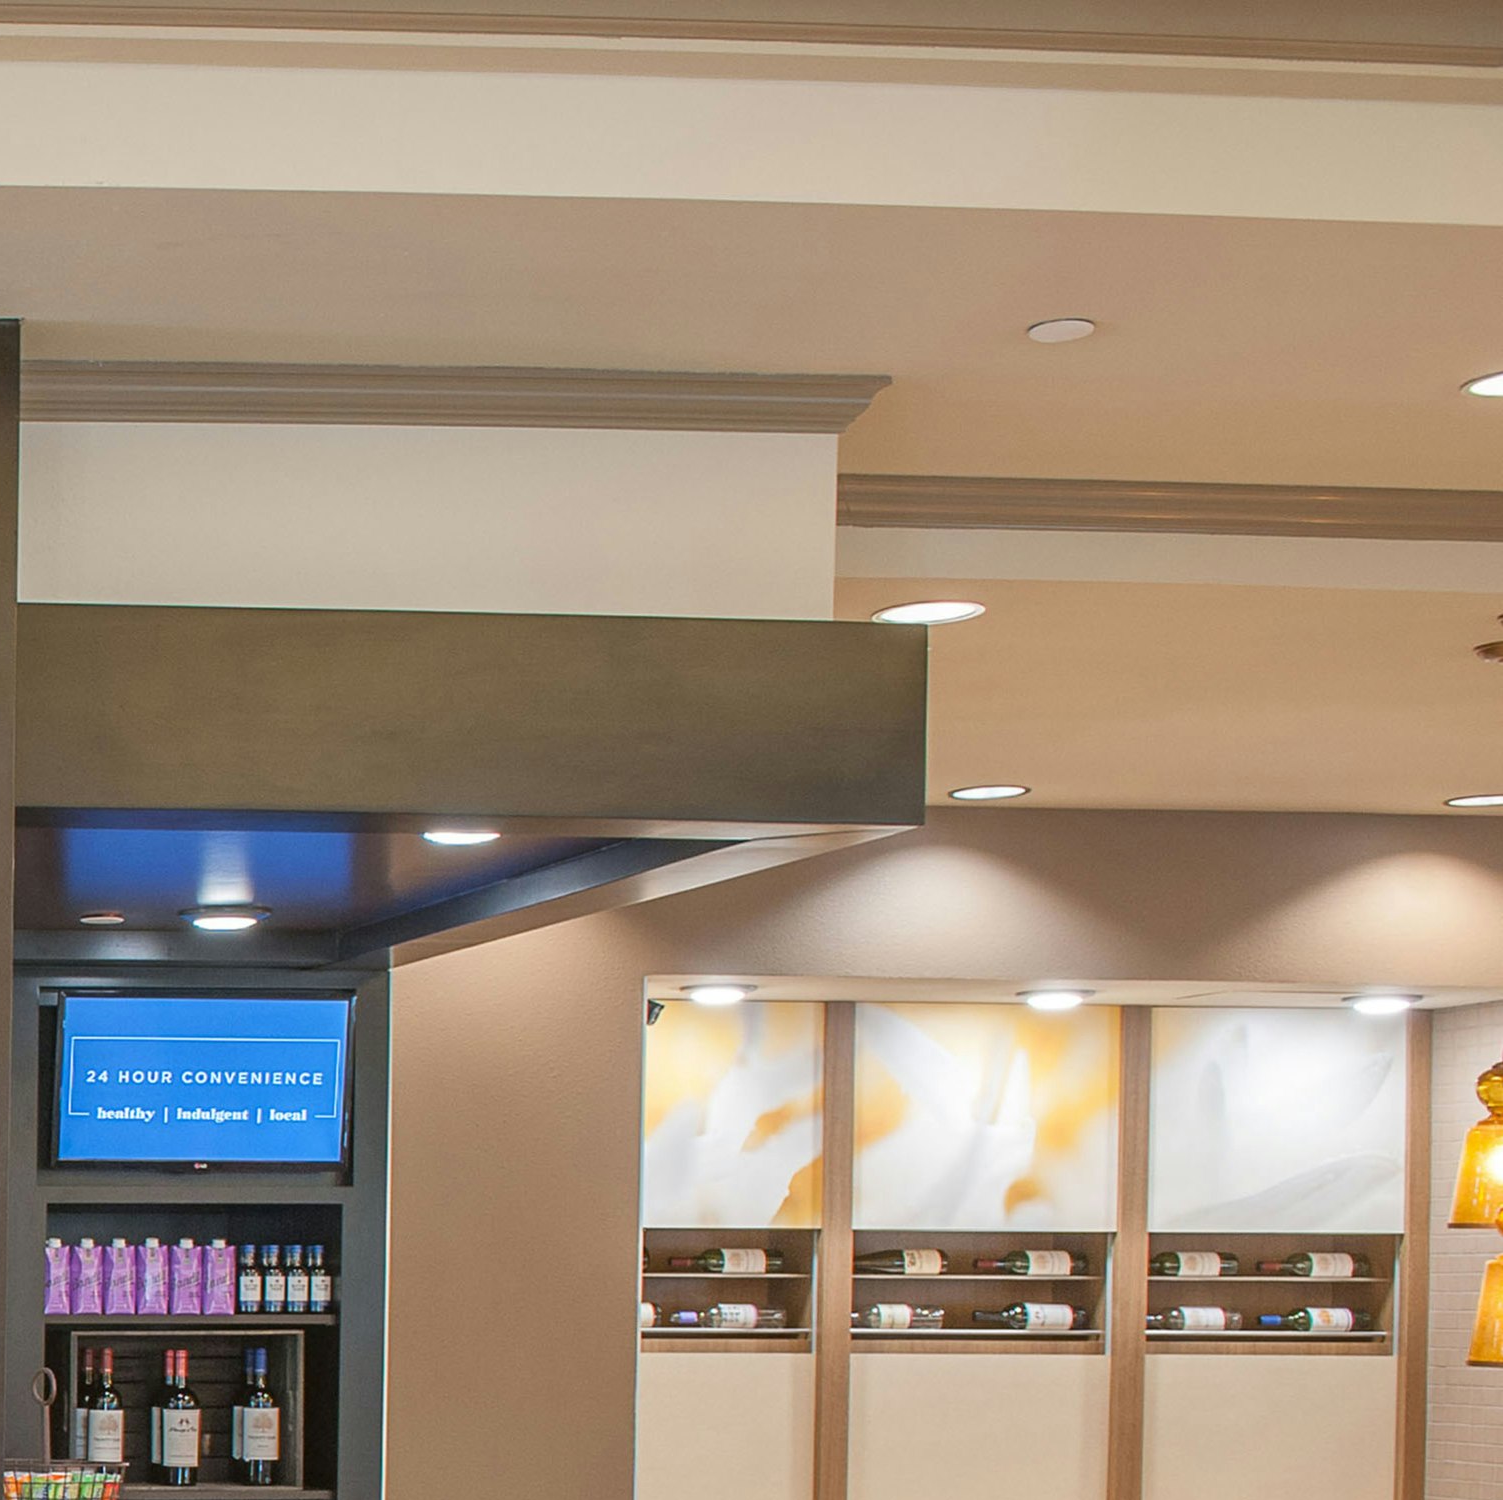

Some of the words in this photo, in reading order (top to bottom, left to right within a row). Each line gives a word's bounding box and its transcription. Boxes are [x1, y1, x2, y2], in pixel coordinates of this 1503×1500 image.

[85, 1070, 109, 1084] 24
[118, 1070, 173, 1084] HOUR
[181, 1071, 324, 1086] CONVENIENCE
[96, 1106, 156, 1123] healthy
[176, 1107, 249, 1124] indulgent
[269, 1108, 308, 1122] local
